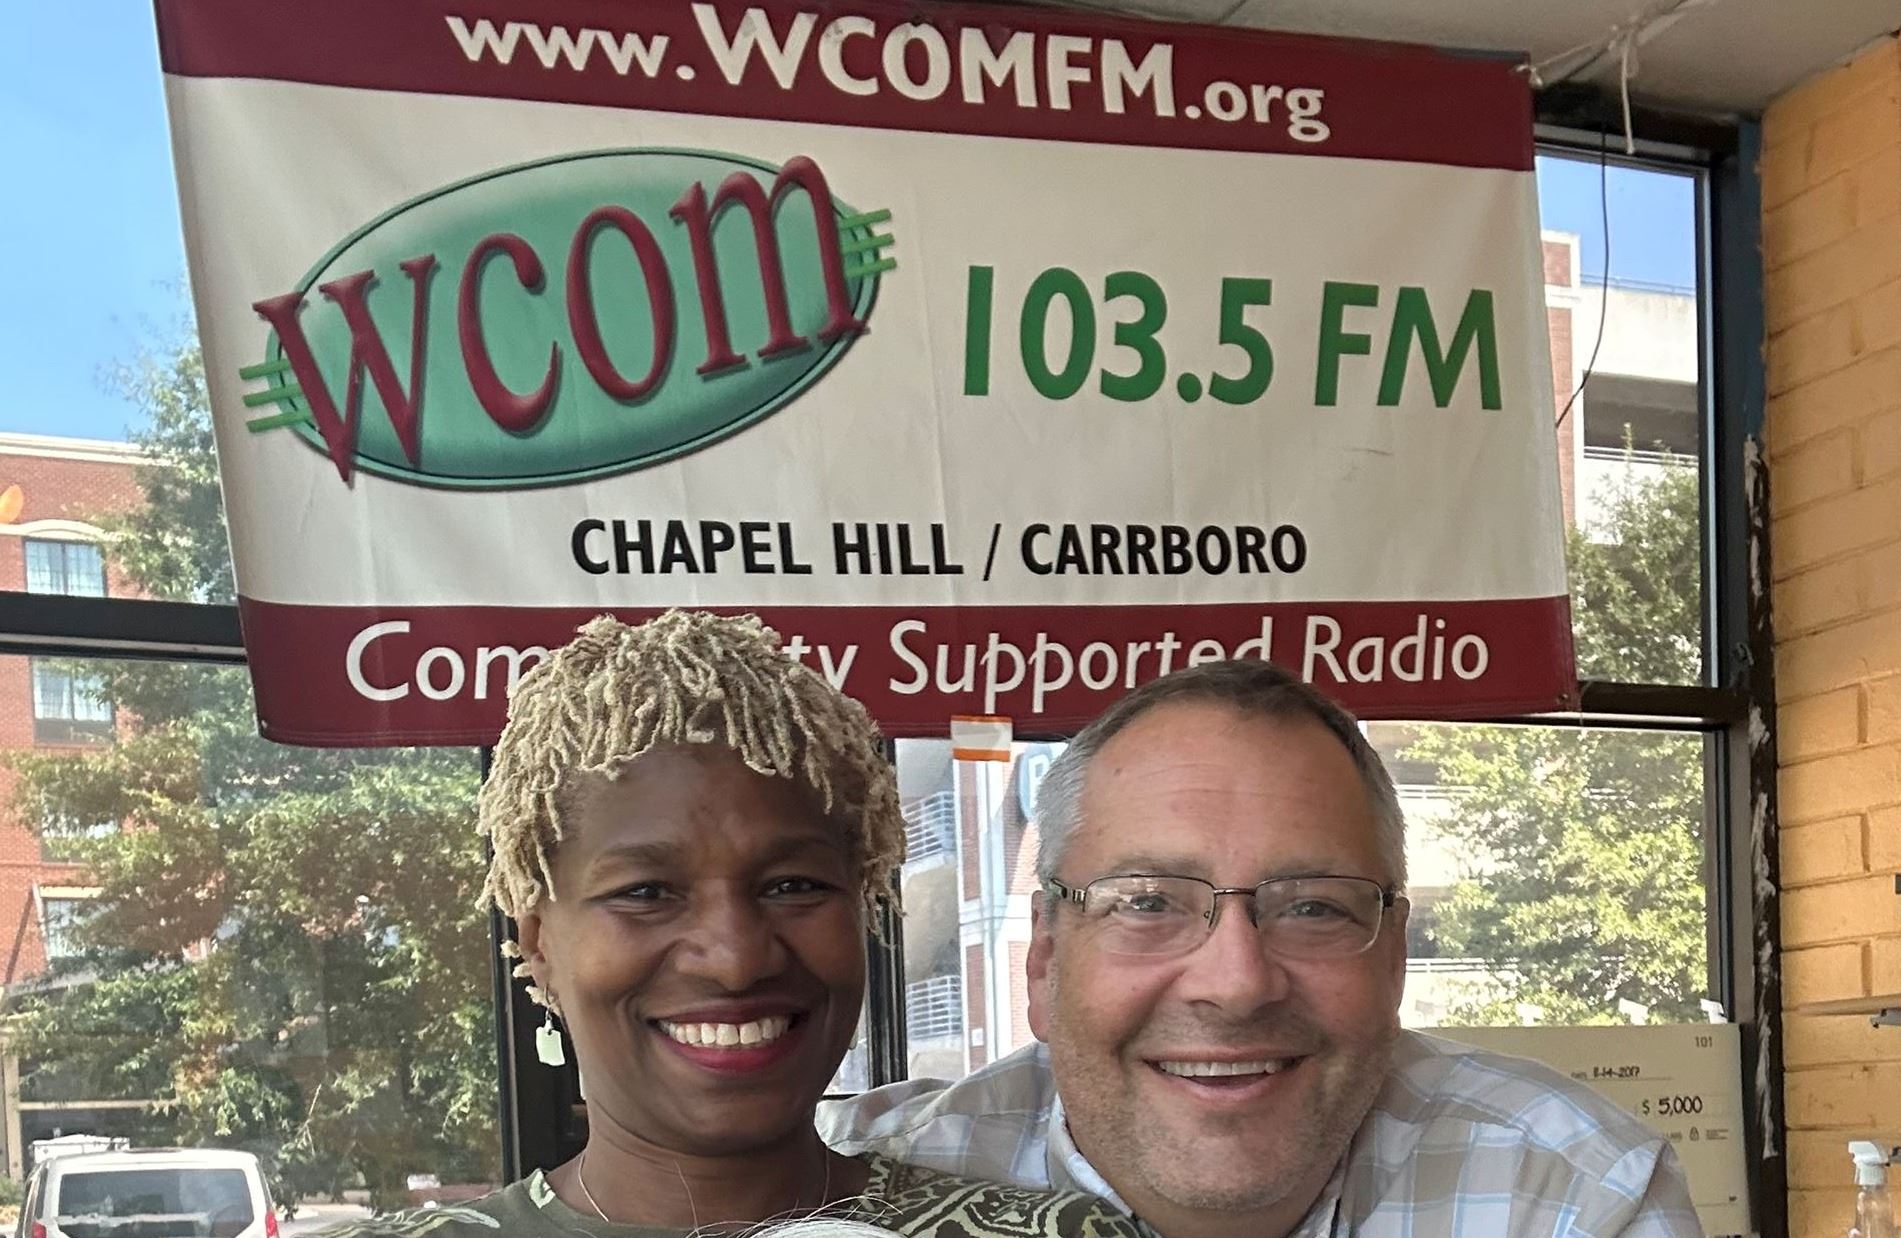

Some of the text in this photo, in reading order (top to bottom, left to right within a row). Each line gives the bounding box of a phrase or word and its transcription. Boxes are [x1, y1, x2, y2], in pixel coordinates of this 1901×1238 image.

[445, 3, 1331, 143] www.WCOMFM.org
[963, 265, 1502, 411] 103.5 FM
[571, 519, 1308, 581] CHAPEL HILL / CARRBORO
[346, 620, 859, 701] Comty
[1302, 613, 1490, 684] Radio
[1696, 1036, 1713, 1048] 101
[1642, 1095, 1703, 1117] $ 5,000
